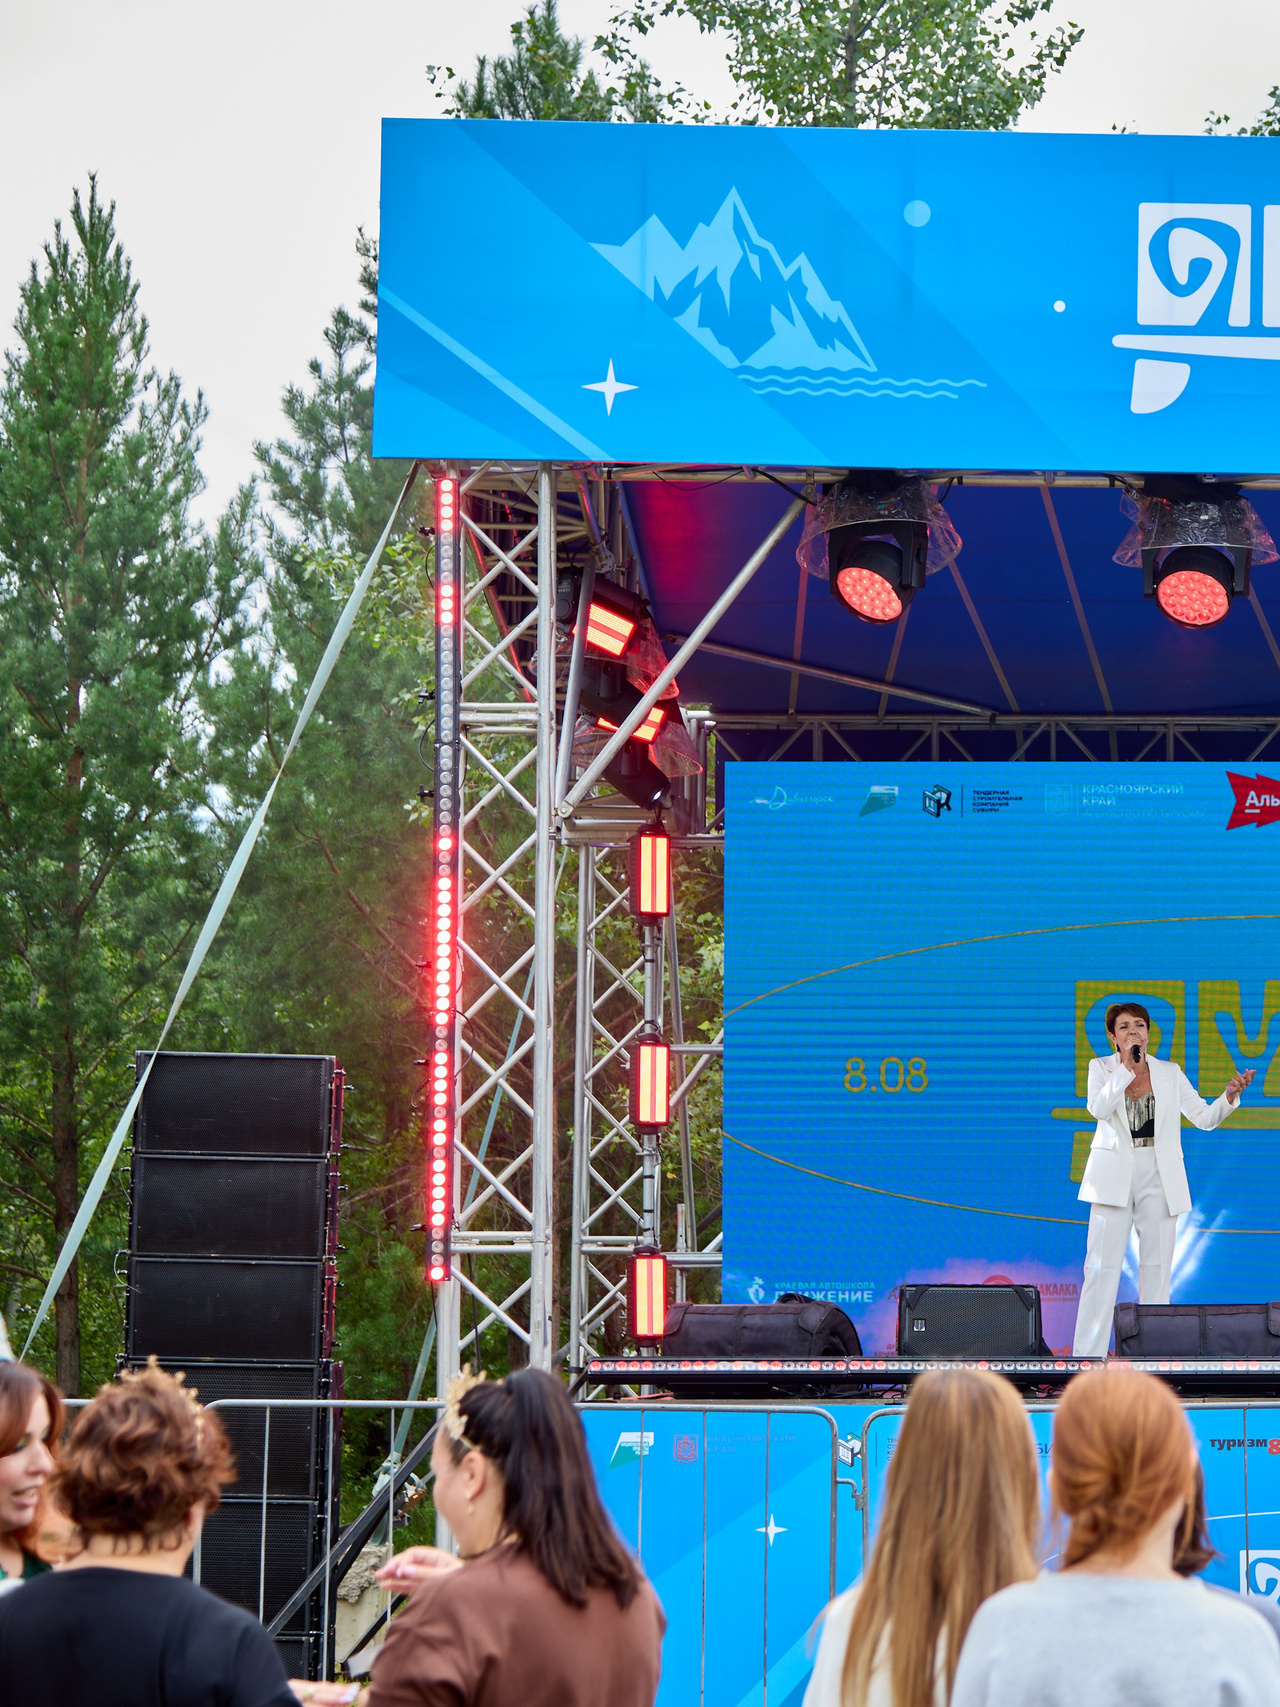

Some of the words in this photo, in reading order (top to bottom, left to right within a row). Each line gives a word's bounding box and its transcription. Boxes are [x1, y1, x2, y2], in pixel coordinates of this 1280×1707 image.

[1082, 783, 1184, 795] КРАСНОЯРСКИЙ
[1082, 795, 1116, 806] КРАЙ
[844, 1058, 929, 1093] 8.08
[775, 1281, 817, 1290] КРАЕВАЯ
[705, 1434, 797, 1443] КРАСНОЯРКИЙ
